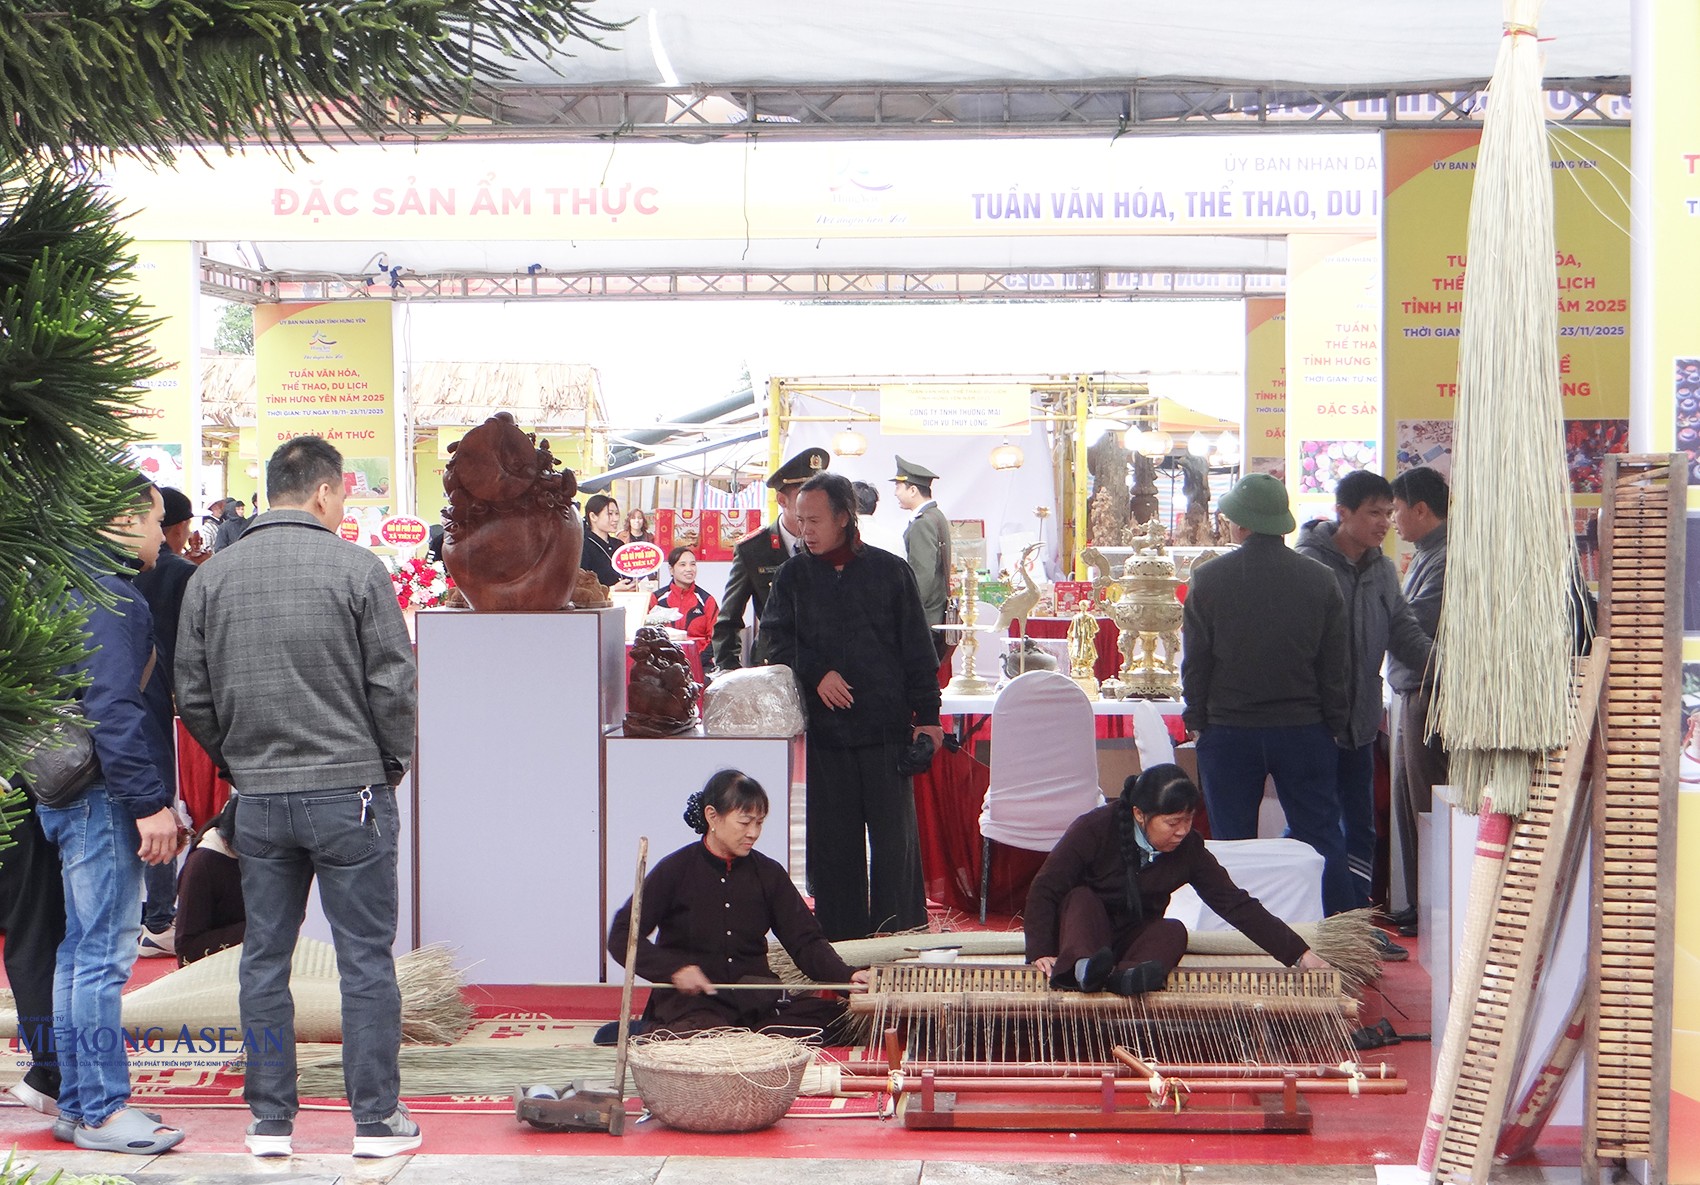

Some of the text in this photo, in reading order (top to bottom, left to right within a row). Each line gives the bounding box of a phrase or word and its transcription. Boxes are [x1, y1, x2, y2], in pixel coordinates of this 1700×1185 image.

[1255, 157, 1291, 171] BAN
[1449, 161, 1468, 170] BAN
[271, 172, 660, 223] ĐẶC SẢN ẨM THỰC
[971, 183, 1041, 220] TUẦN
[1051, 186, 1104, 219] VĂN
[1114, 186, 1175, 222] HÓA,
[1185, 179, 1233, 218] THỂ
[1243, 190, 1316, 220] THAO,
[1327, 190, 1361, 216] DU
[1446, 250, 1582, 269] TU ÓA,
[1402, 296, 1441, 314] TỈNH
[1558, 299, 1580, 313] ĂM
[1586, 300, 1627, 313] 2025
[1403, 327, 1431, 338] THỜI
[1560, 326, 1625, 337] 23/11/2025
[1352, 341, 1377, 349] THA
[317, 368, 335, 377] VĂN
[302, 383, 329, 391] THAO,
[1272, 380, 1285, 388] TH
[290, 395, 316, 403] HƯNG
[319, 394, 337, 403] YÊN
[340, 394, 360, 402] NĂM
[363, 394, 385, 402] 2025
[1317, 402, 1347, 418] ĐẶC
[346, 430, 375, 440] THỰC
